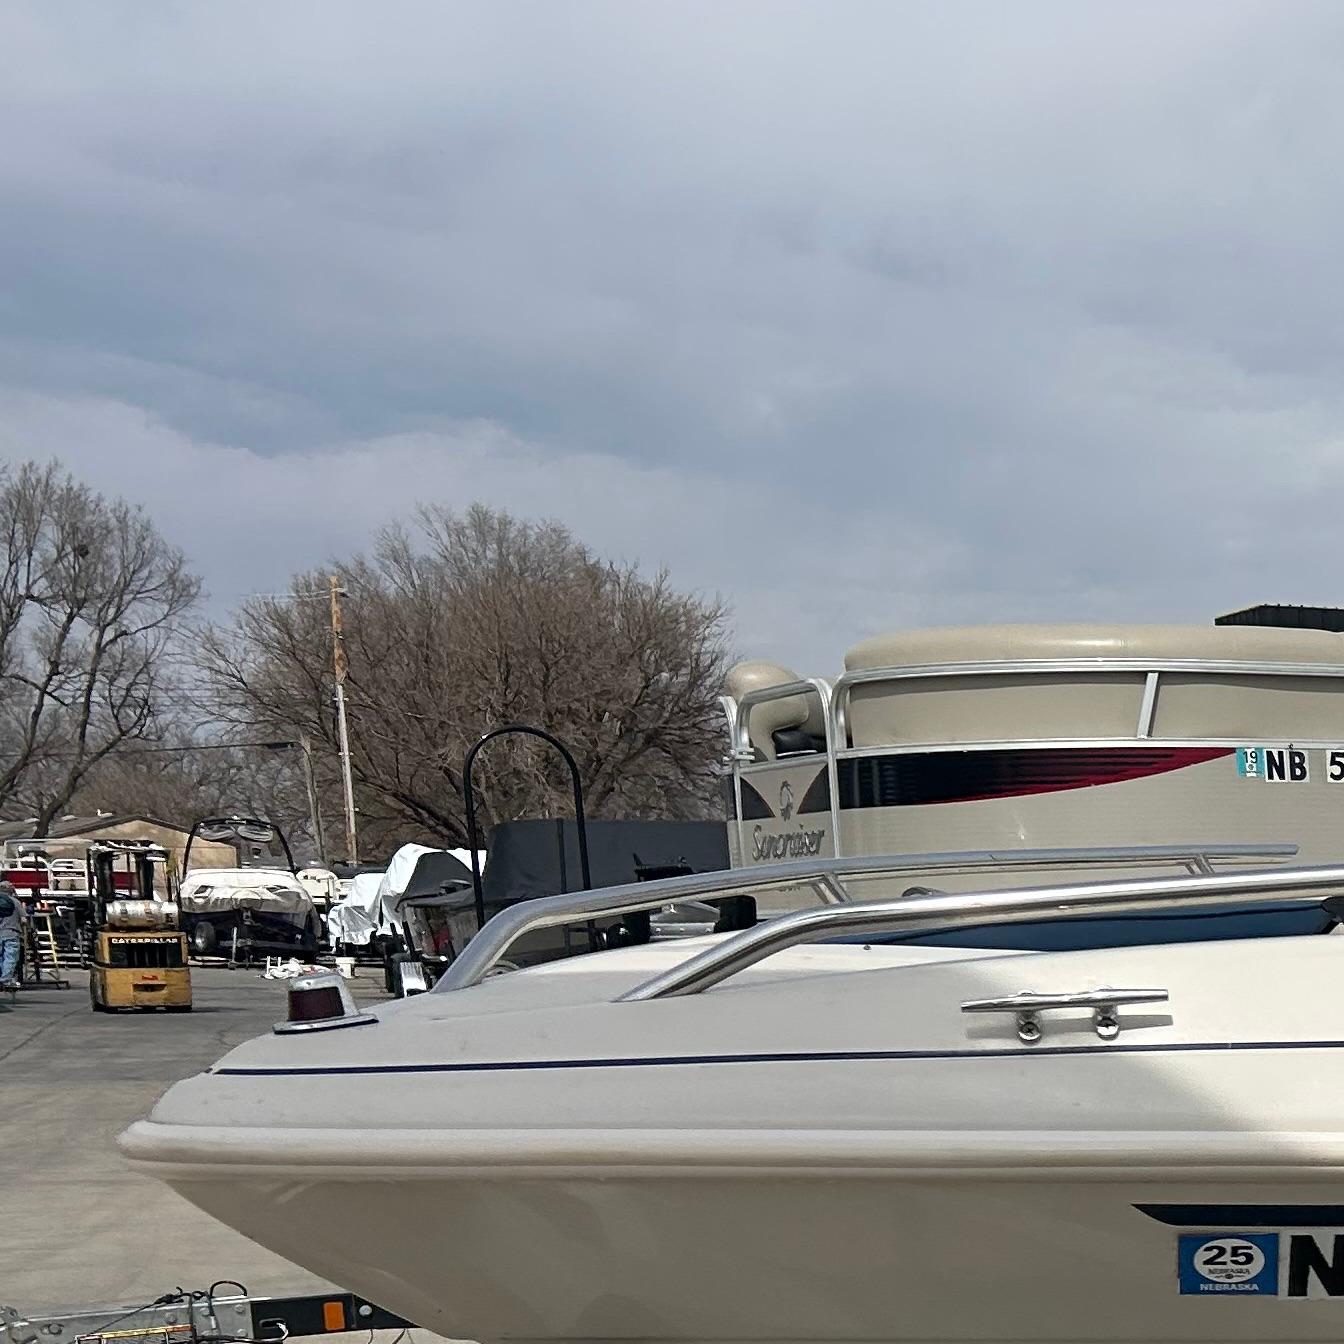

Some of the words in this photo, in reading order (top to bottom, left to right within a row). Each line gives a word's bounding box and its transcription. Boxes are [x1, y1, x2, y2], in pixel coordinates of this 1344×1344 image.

[1242, 751, 1258, 764] 19
[1265, 750, 1308, 781] NB
[1202, 1245, 1254, 1266] 25
[1200, 1283, 1259, 1291] NEBRASKA
